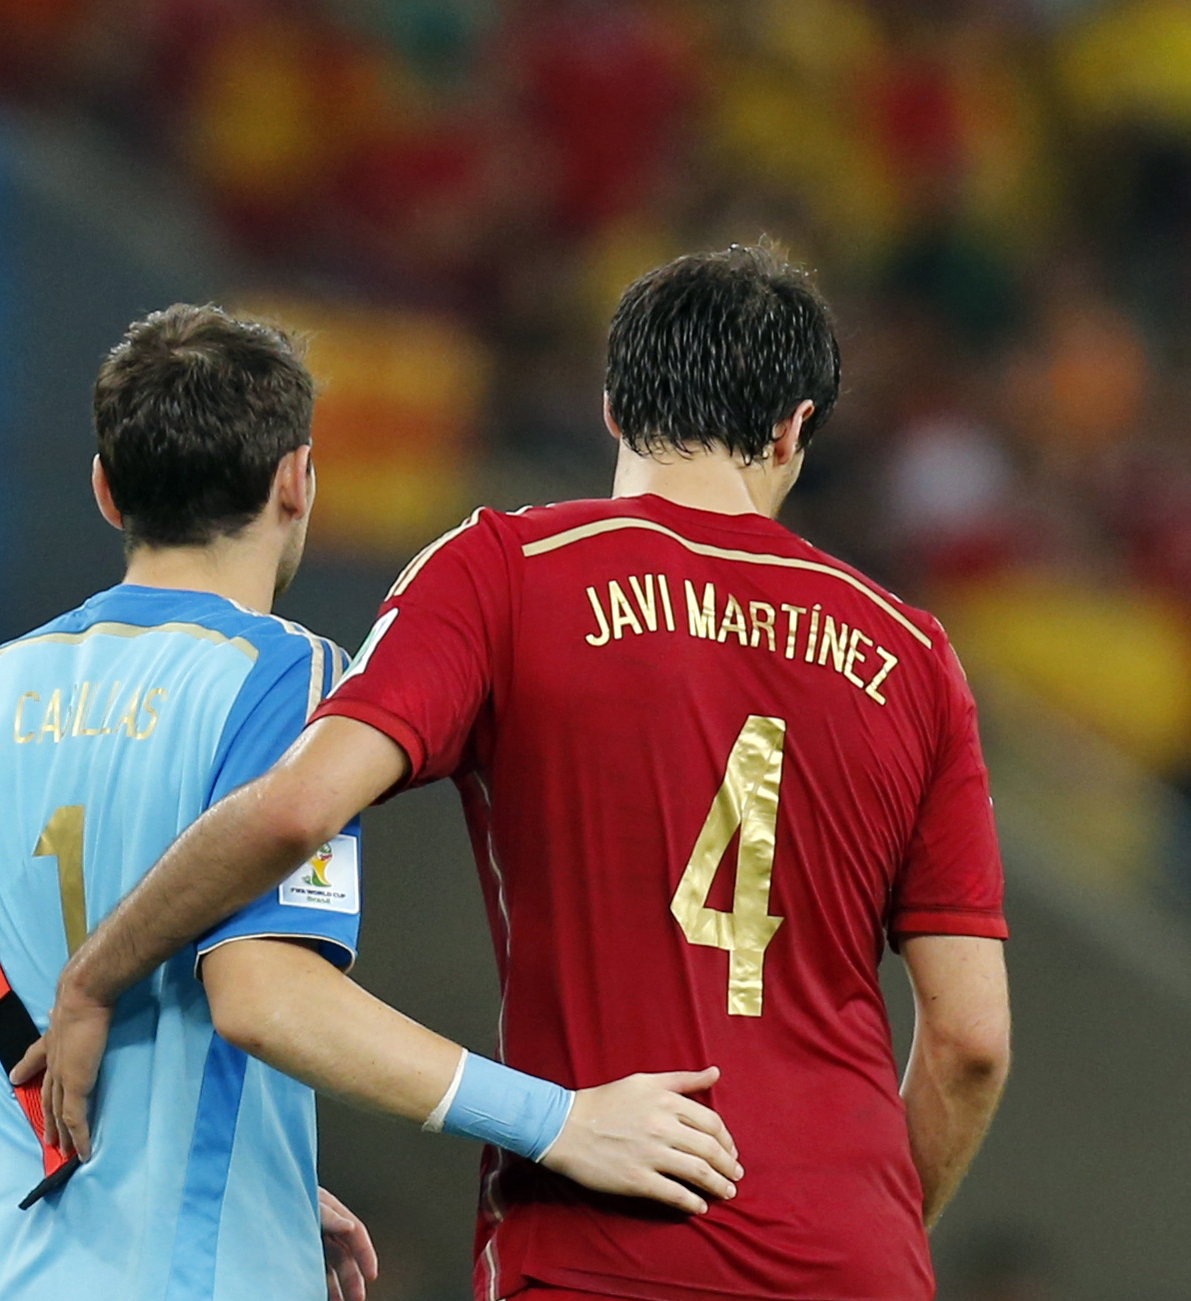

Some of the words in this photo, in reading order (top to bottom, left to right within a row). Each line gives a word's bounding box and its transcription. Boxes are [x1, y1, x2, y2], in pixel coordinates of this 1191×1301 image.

[585, 574, 675, 646] JAVI
[684, 579, 898, 706] MARTÍNEZ
[32, 806, 88, 960] 1
[670, 714, 786, 1017] 4
